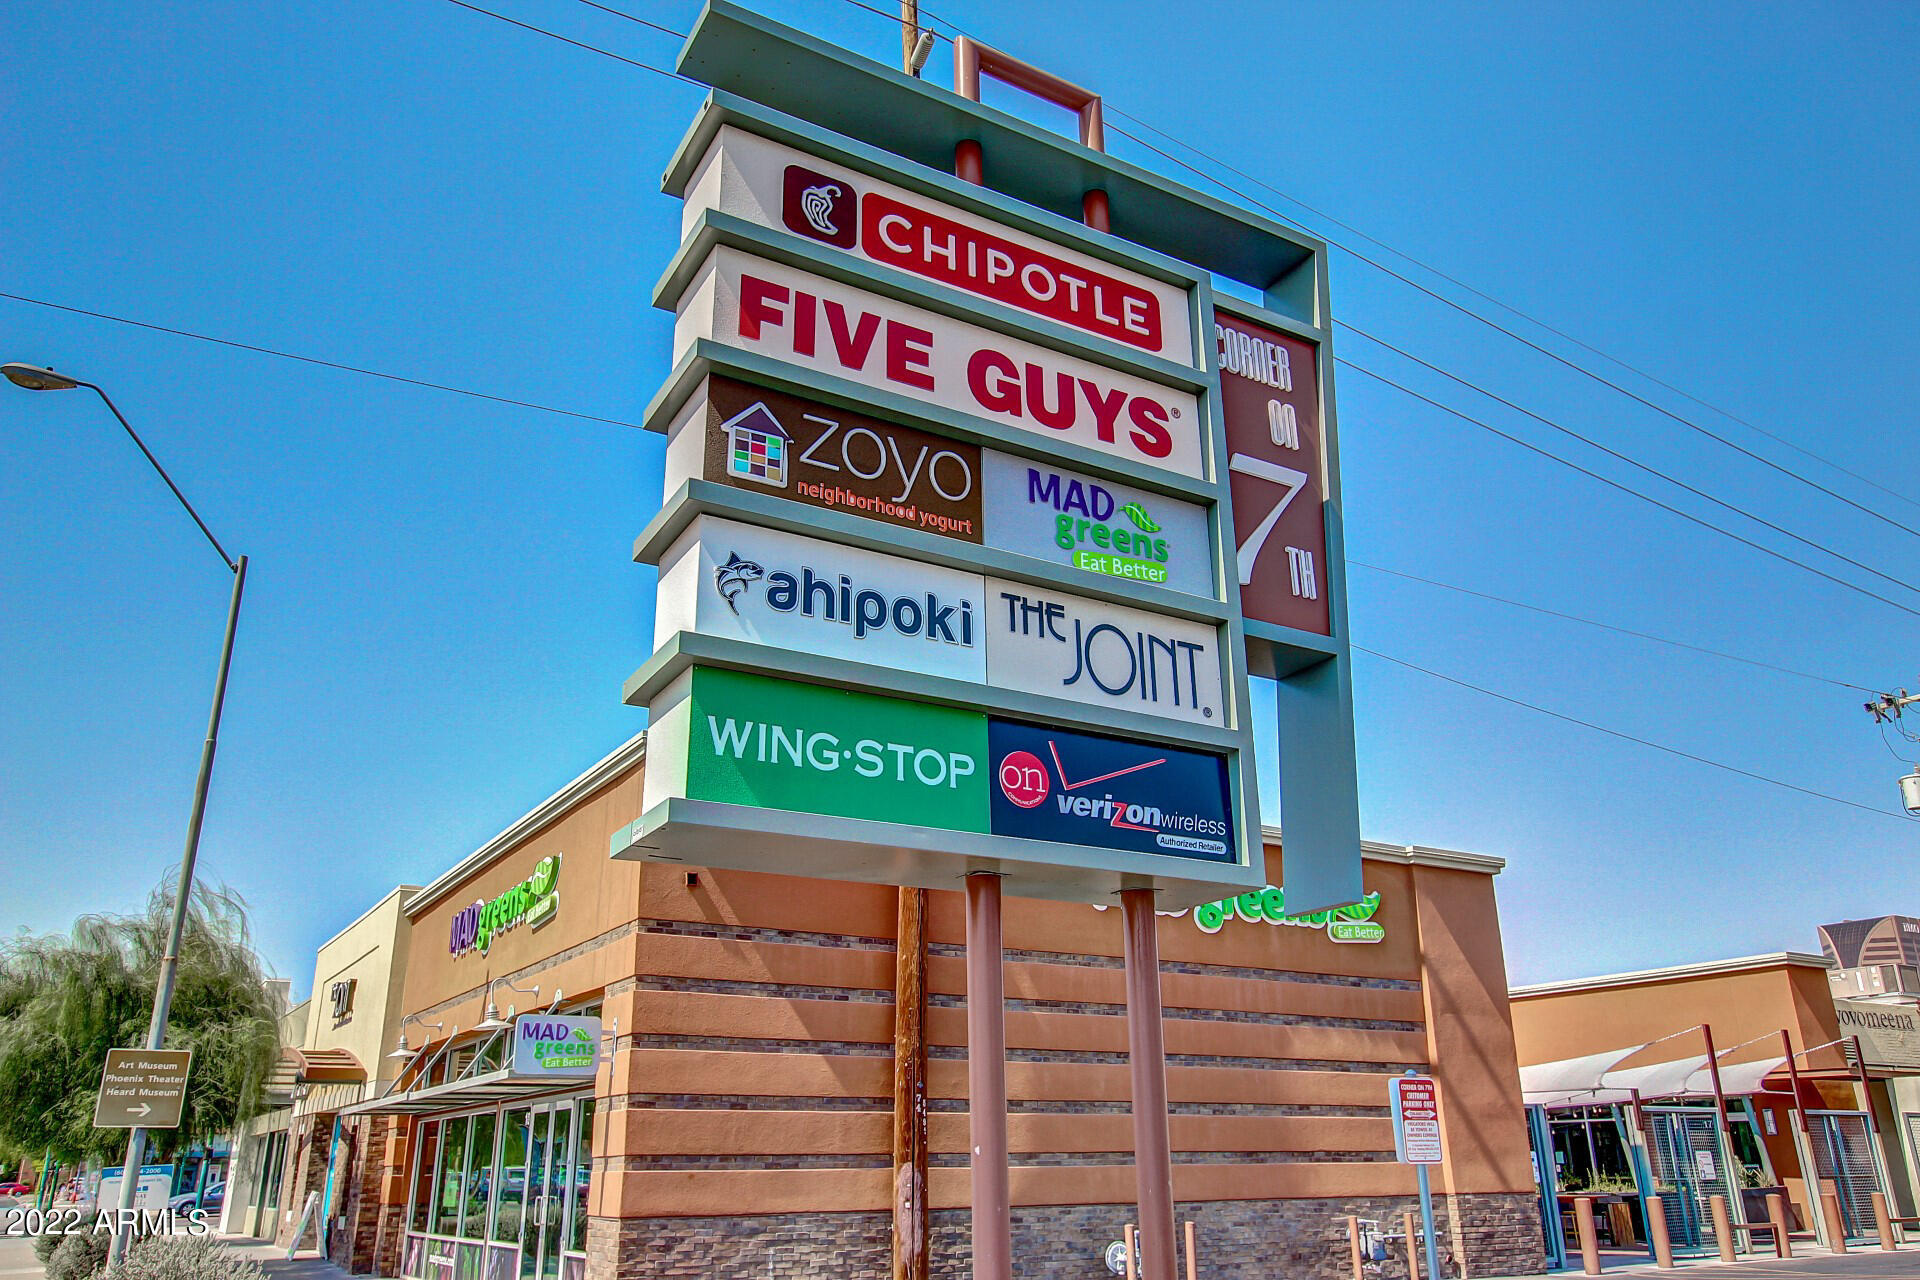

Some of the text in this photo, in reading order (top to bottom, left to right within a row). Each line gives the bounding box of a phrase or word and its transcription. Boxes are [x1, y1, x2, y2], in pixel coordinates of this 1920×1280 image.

[878, 214, 1150, 336] CHIPOTLE
[738, 273, 1173, 458] FIVE GUYS
[1215, 323, 1292, 392] CORNER
[797, 481, 972, 534] neighborhood yogurt
[1027, 468, 1115, 521] MAD
[1055, 514, 1168, 562] greens
[1080, 553, 1165, 581] Eat Better
[765, 566, 973, 648] ahipoki
[1001, 592, 1067, 642] THE
[1063, 618, 1204, 709] JOINT
[1001, 765, 1046, 793] on
[1160, 836, 1223, 852] Authorized Retailer
[449, 904, 482, 954] MAD
[476, 881, 531, 951] greens
[1338, 926, 1385, 939] Eat Better
[522, 1022, 569, 1041] MAD
[534, 1041, 596, 1060] greens
[105, 1074, 184, 1083] Phoenix Theater
[118, 1061, 178, 1070] Art Museum
[545, 1057, 592, 1068] Eat Better
[106, 1087, 179, 1097] Heard Museum
